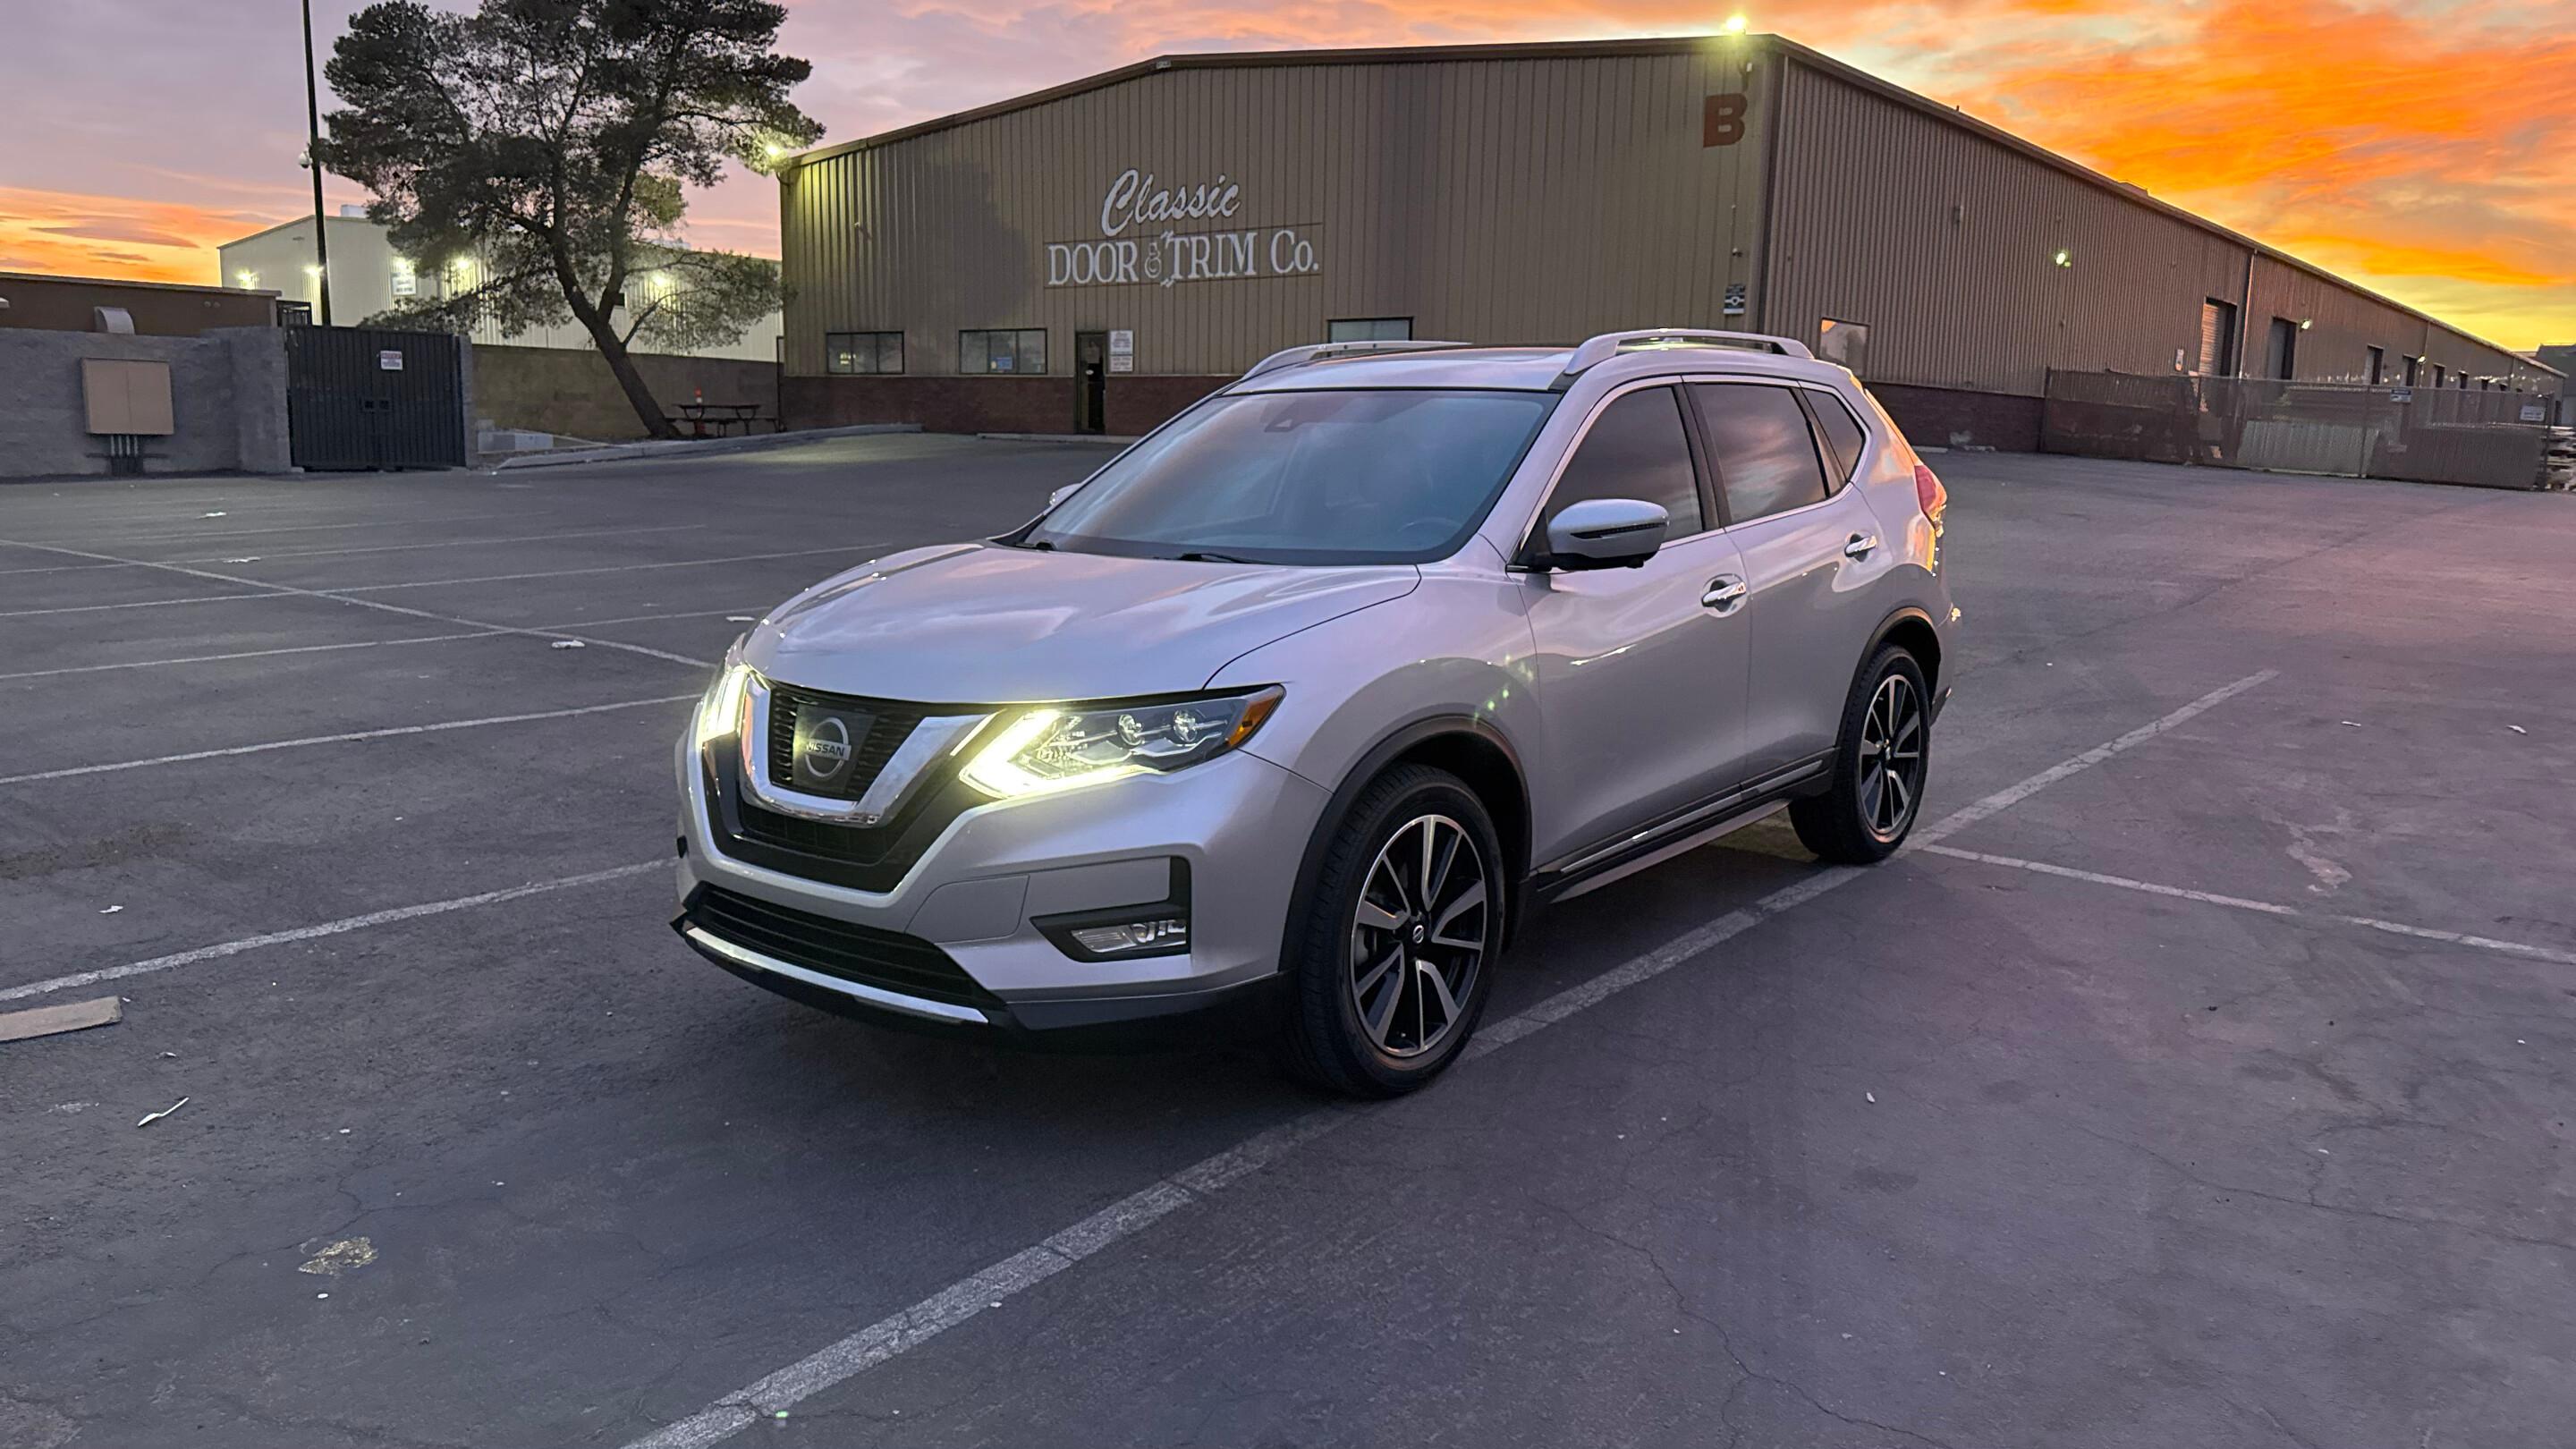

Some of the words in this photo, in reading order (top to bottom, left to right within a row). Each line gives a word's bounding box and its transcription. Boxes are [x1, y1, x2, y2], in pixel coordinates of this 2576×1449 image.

[1703, 92, 1748, 148] B
[1101, 168, 1241, 237] Classic
[1047, 241, 1139, 285] DOOR
[1160, 230, 1258, 287] TRIM
[1270, 229, 1319, 274] Co.
[807, 741, 845, 758] NISSAN
